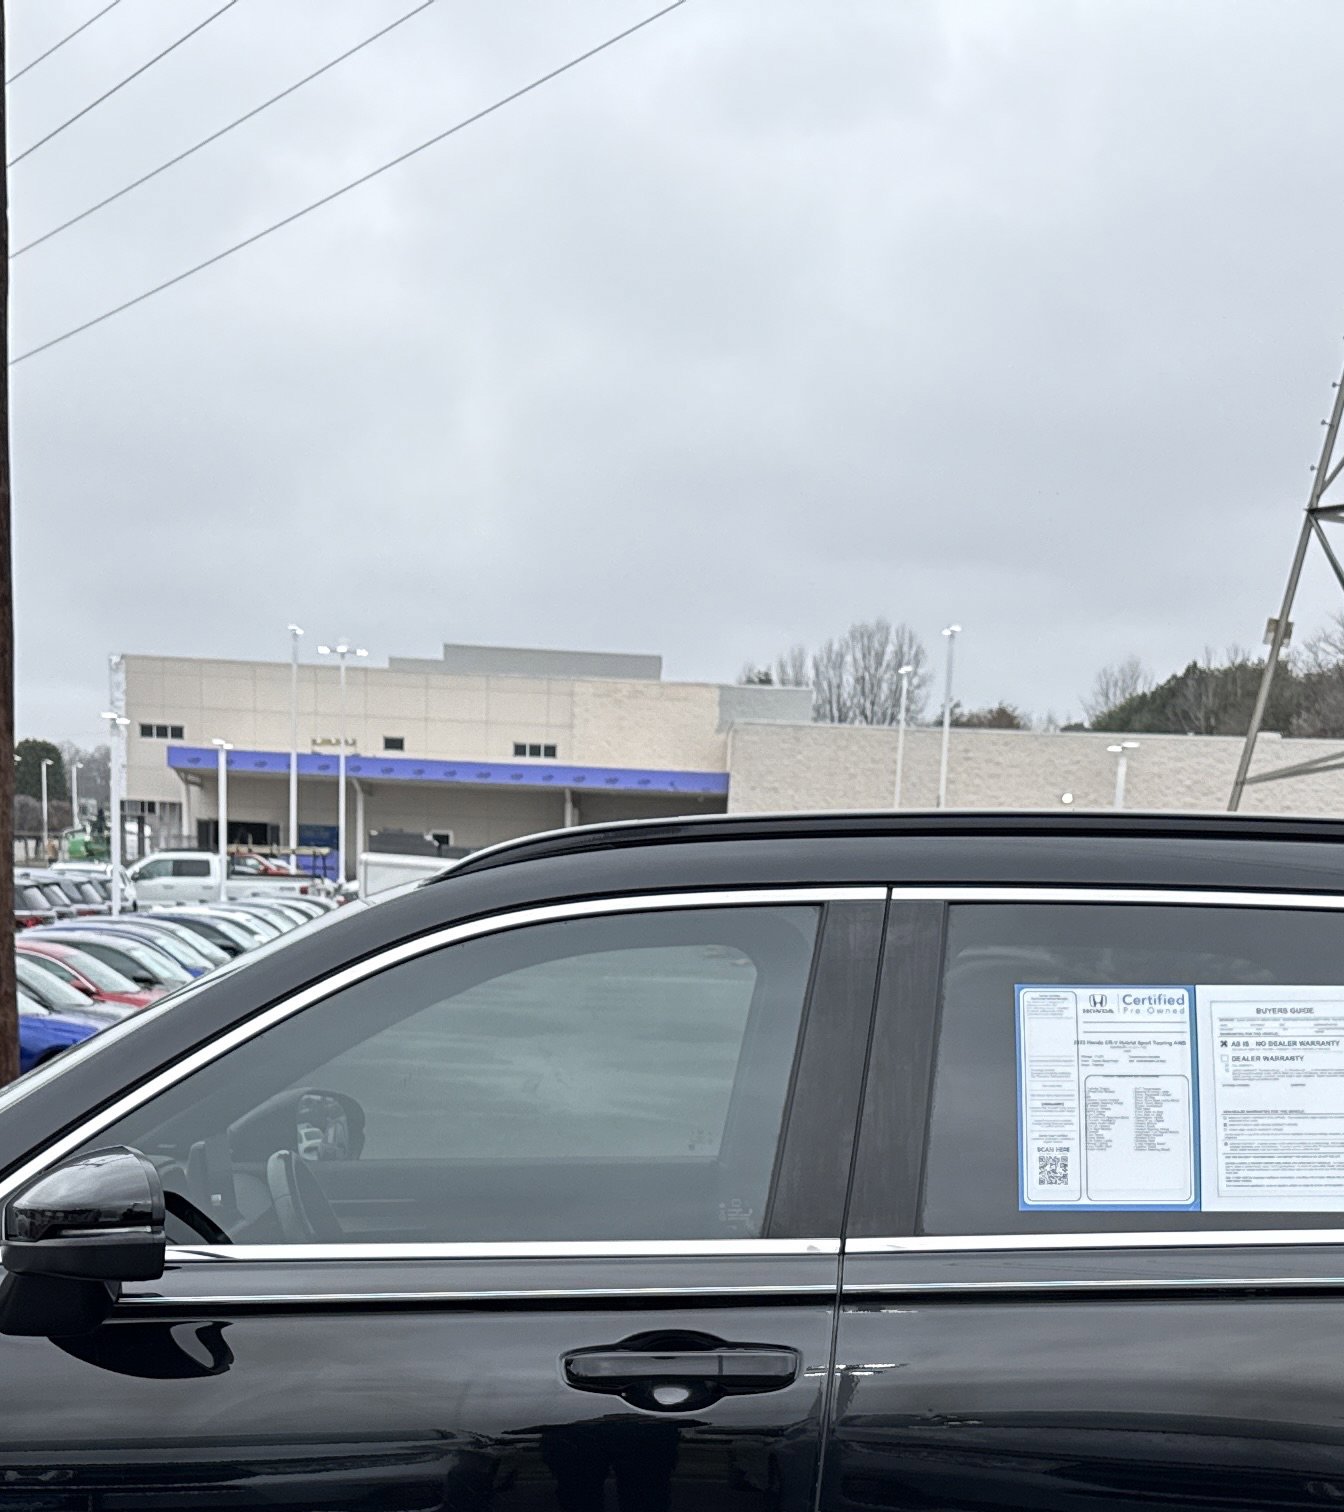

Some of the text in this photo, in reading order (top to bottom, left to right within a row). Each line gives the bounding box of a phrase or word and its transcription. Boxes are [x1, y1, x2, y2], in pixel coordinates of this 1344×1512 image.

[1121, 993, 1185, 1006] Certified
[1255, 1007, 1315, 1015] BUYERS GUIDE
